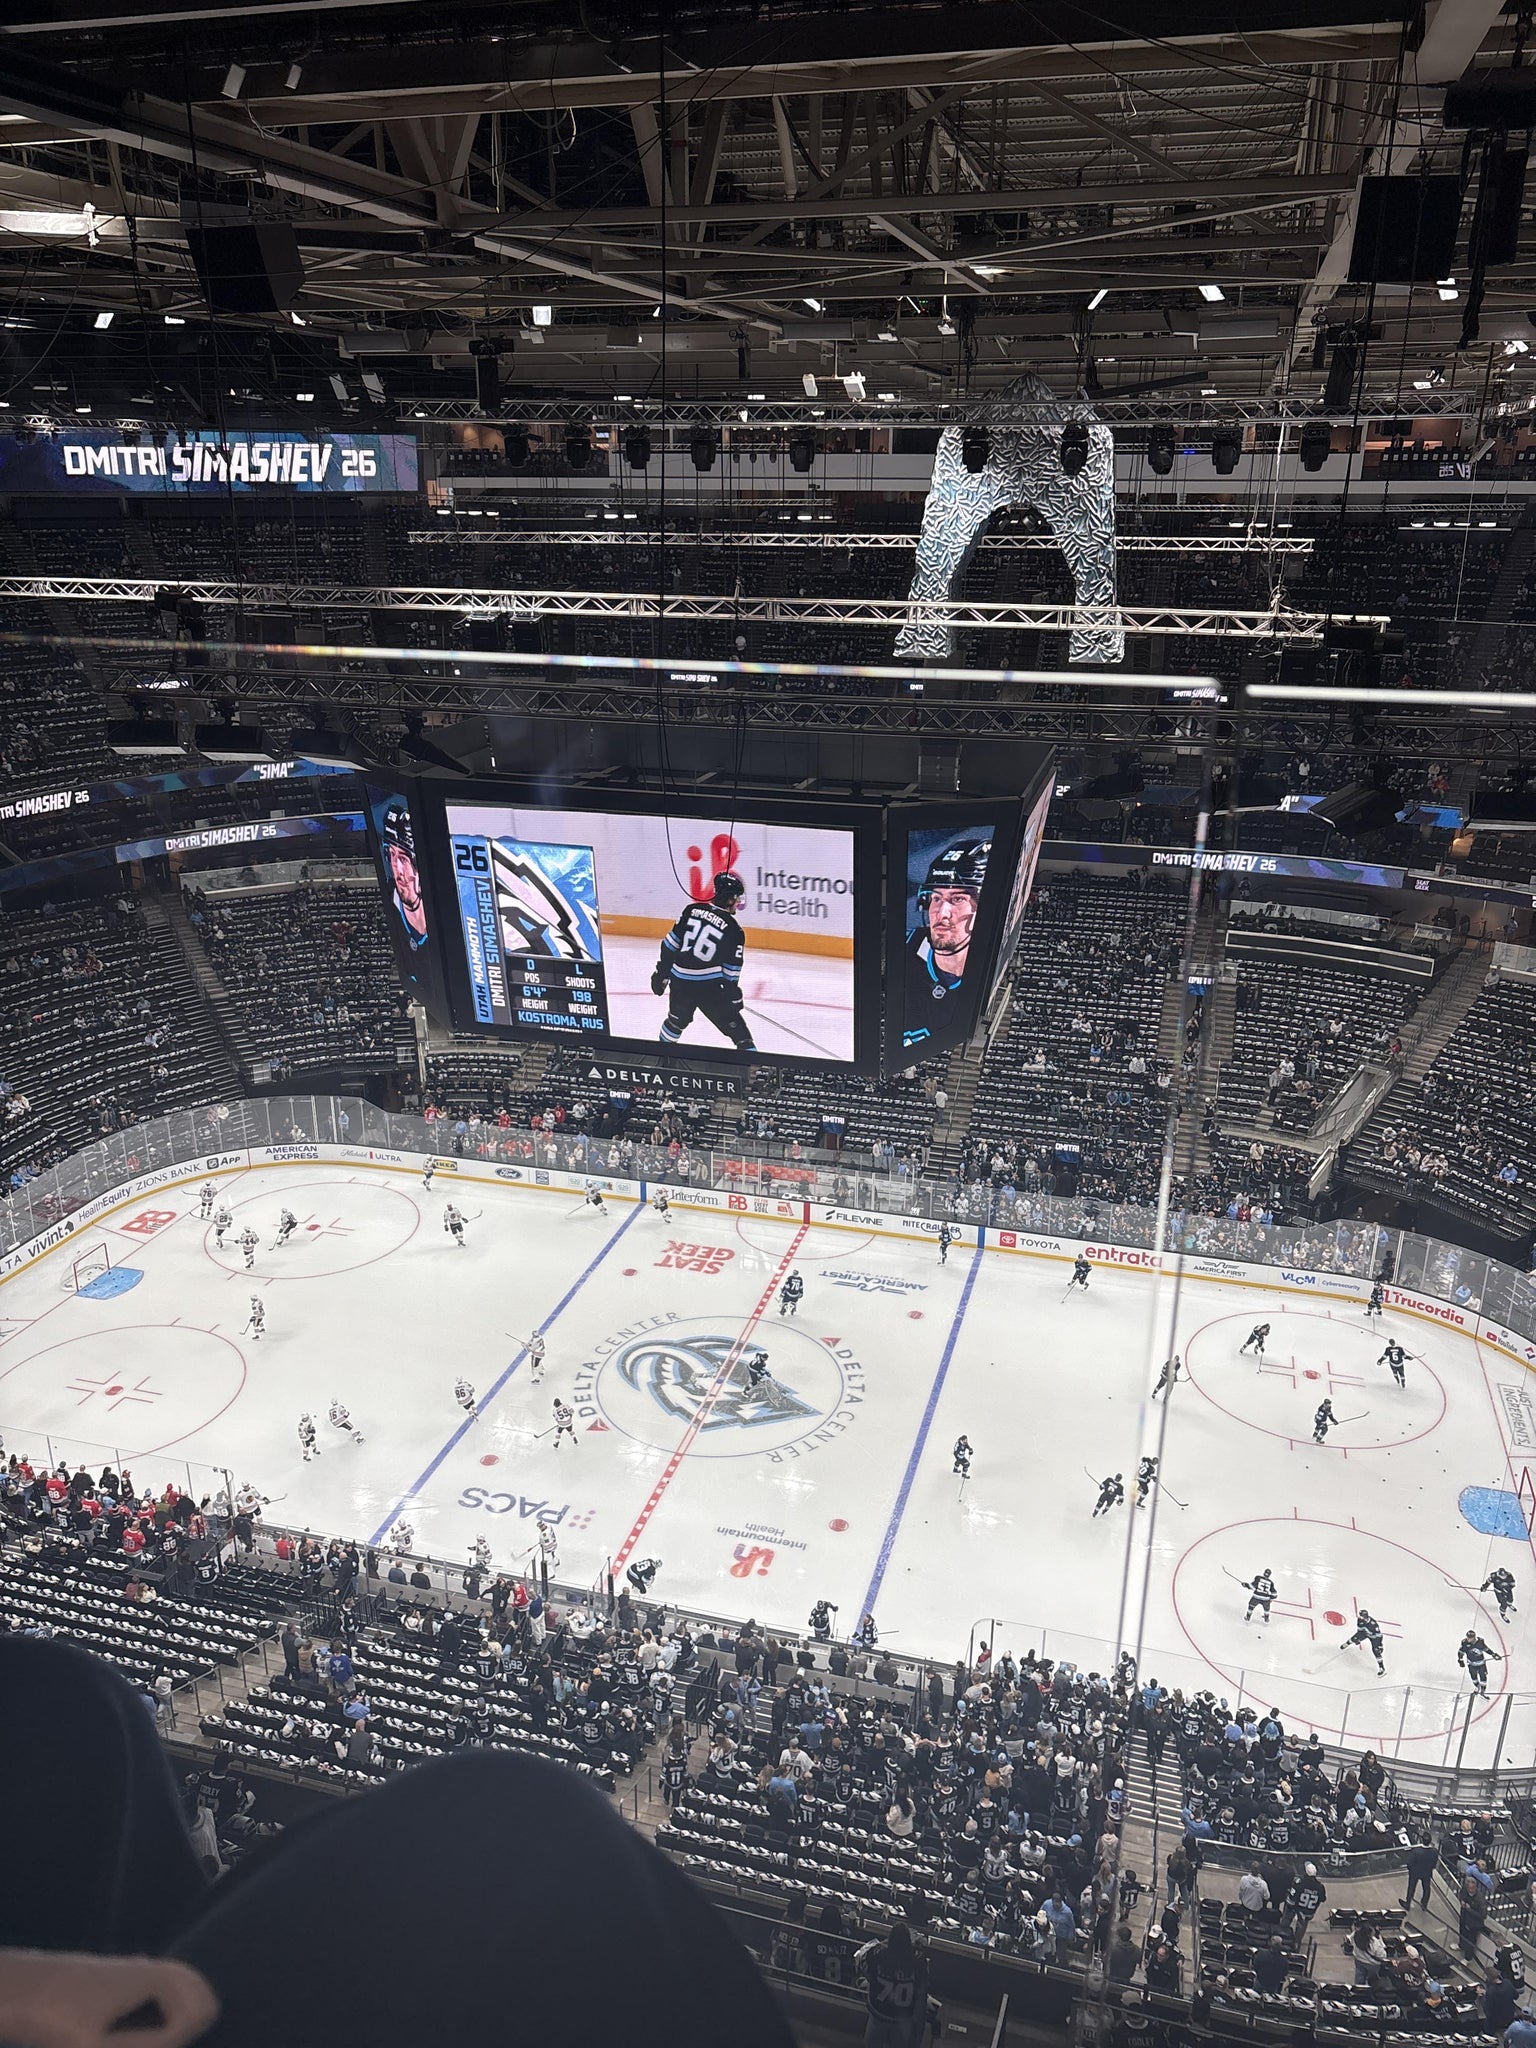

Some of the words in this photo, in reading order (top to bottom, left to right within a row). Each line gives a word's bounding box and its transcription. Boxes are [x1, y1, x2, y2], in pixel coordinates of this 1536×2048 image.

[63, 446, 167, 475] DMITRI
[172, 443, 333, 482] SIMASHEV
[342, 450, 376, 476] 26
[16, 791, 72, 818] SIMASHEV
[75, 790, 89, 804] 26
[165, 837, 200, 851] DMITRI
[200, 825, 259, 848] SIMASHEV
[262, 826, 277, 838] 26
[455, 844, 490, 872] 26
[942, 849, 965, 862] 26
[1152, 853, 1192, 866] DMITRI
[1191, 854, 1258, 871] SIMASHEV
[1260, 859, 1277, 871] 26
[757, 892, 829, 919] Health
[475, 880, 500, 964] SIMASHEV
[691, 908, 728, 931] SIMASHEV
[680, 918, 724, 962] 26
[466, 916, 485, 984] MAMMOTH
[527, 959, 535, 970] D
[575, 964, 583, 975] L
[524, 973, 540, 983] POS
[565, 976, 595, 989] SHOOTS
[488, 965, 506, 1007] DMITRI
[475, 985, 490, 1018] UTAH
[522, 998, 549, 1010] HEIGHT
[572, 991, 592, 1003] 198
[569, 1003, 598, 1015] WEIGHT
[518, 1011, 580, 1028] KOSTROMA,
[581, 1017, 604, 1030] RUS
[606, 1069, 664, 1085] DELTA
[669, 1076, 736, 1093] CENTER
[265, 1145, 318, 1155] AMERICAN
[1055, 1143, 1080, 1152] DMITRI
[273, 1153, 319, 1161] EXPRESS
[375, 1153, 402, 1162] ULTRA
[135, 1173, 168, 1192] ZIONS
[170, 1162, 202, 1178] BANK
[500, 1168, 517, 1178] Ford
[671, 1189, 719, 1206] Interform
[836, 1212, 883, 1226] FILEVINE
[27, 1226, 65, 1257] vivint
[1020, 1238, 1061, 1250] TOYOTA
[662, 1239, 735, 1261] GEEK
[1085, 1246, 1163, 1268] entrata
[654, 1254, 725, 1275] SEAT
[1193, 1265, 1226, 1276] AMERICA
[1226, 1268, 1247, 1277] FIRST
[819, 1270, 863, 1282] FIRST
[865, 1276, 928, 1291] AMERICA
[1393, 1291, 1465, 1325] Trucordia
[1497, 1337, 1518, 1354] YouTube
[1391, 1350, 1399, 1361] 6
[573, 1359, 603, 1418] DELTA
[594, 1311, 681, 1355] CENTER
[834, 1349, 867, 1404] DELTA
[557, 1408, 570, 1420] 59
[766, 1411, 855, 1464] CENTER
[457, 1487, 570, 1524] PACS
[745, 1523, 785, 1537] Health
[716, 1526, 808, 1551] Intermountain
[480, 1664, 489, 1675] 11
[655, 1699, 662, 1710] 8
[583, 1727, 598, 1738] 92
[1185, 1725, 1199, 1735] 92
[824, 1758, 840, 1769] 92
[671, 1772, 680, 1784] 11
[801, 1810, 813, 1823] 11
[983, 1817, 991, 1829] 9
[1300, 1894, 1319, 1908] 92
[825, 1956, 841, 1983] 8
[876, 1976, 914, 2007] 70
